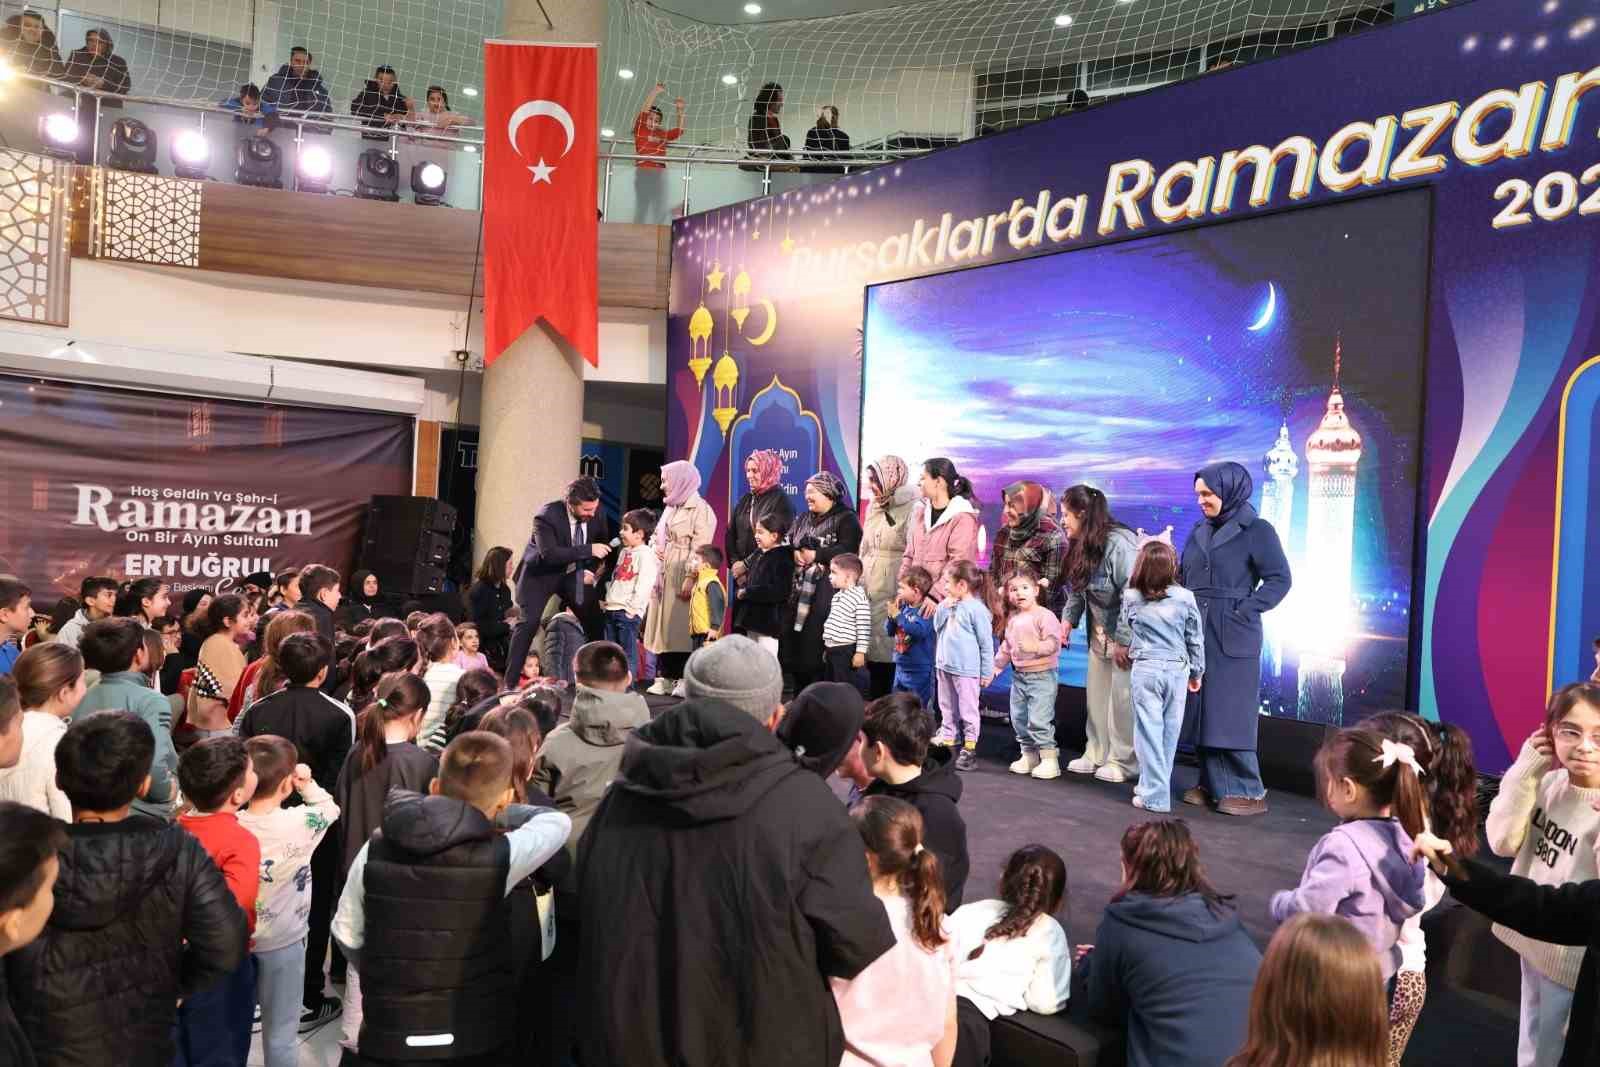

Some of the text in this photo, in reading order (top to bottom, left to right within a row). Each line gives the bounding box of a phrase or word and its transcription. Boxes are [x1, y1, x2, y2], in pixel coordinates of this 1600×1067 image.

[131, 486, 278, 507] Hoş Geldin Ya Şehr-i
[71, 483, 312, 536] Ramazan
[126, 530, 279, 548] On Bir Ayın Sultanı
[124, 552, 275, 578] ERTUĞRUL
